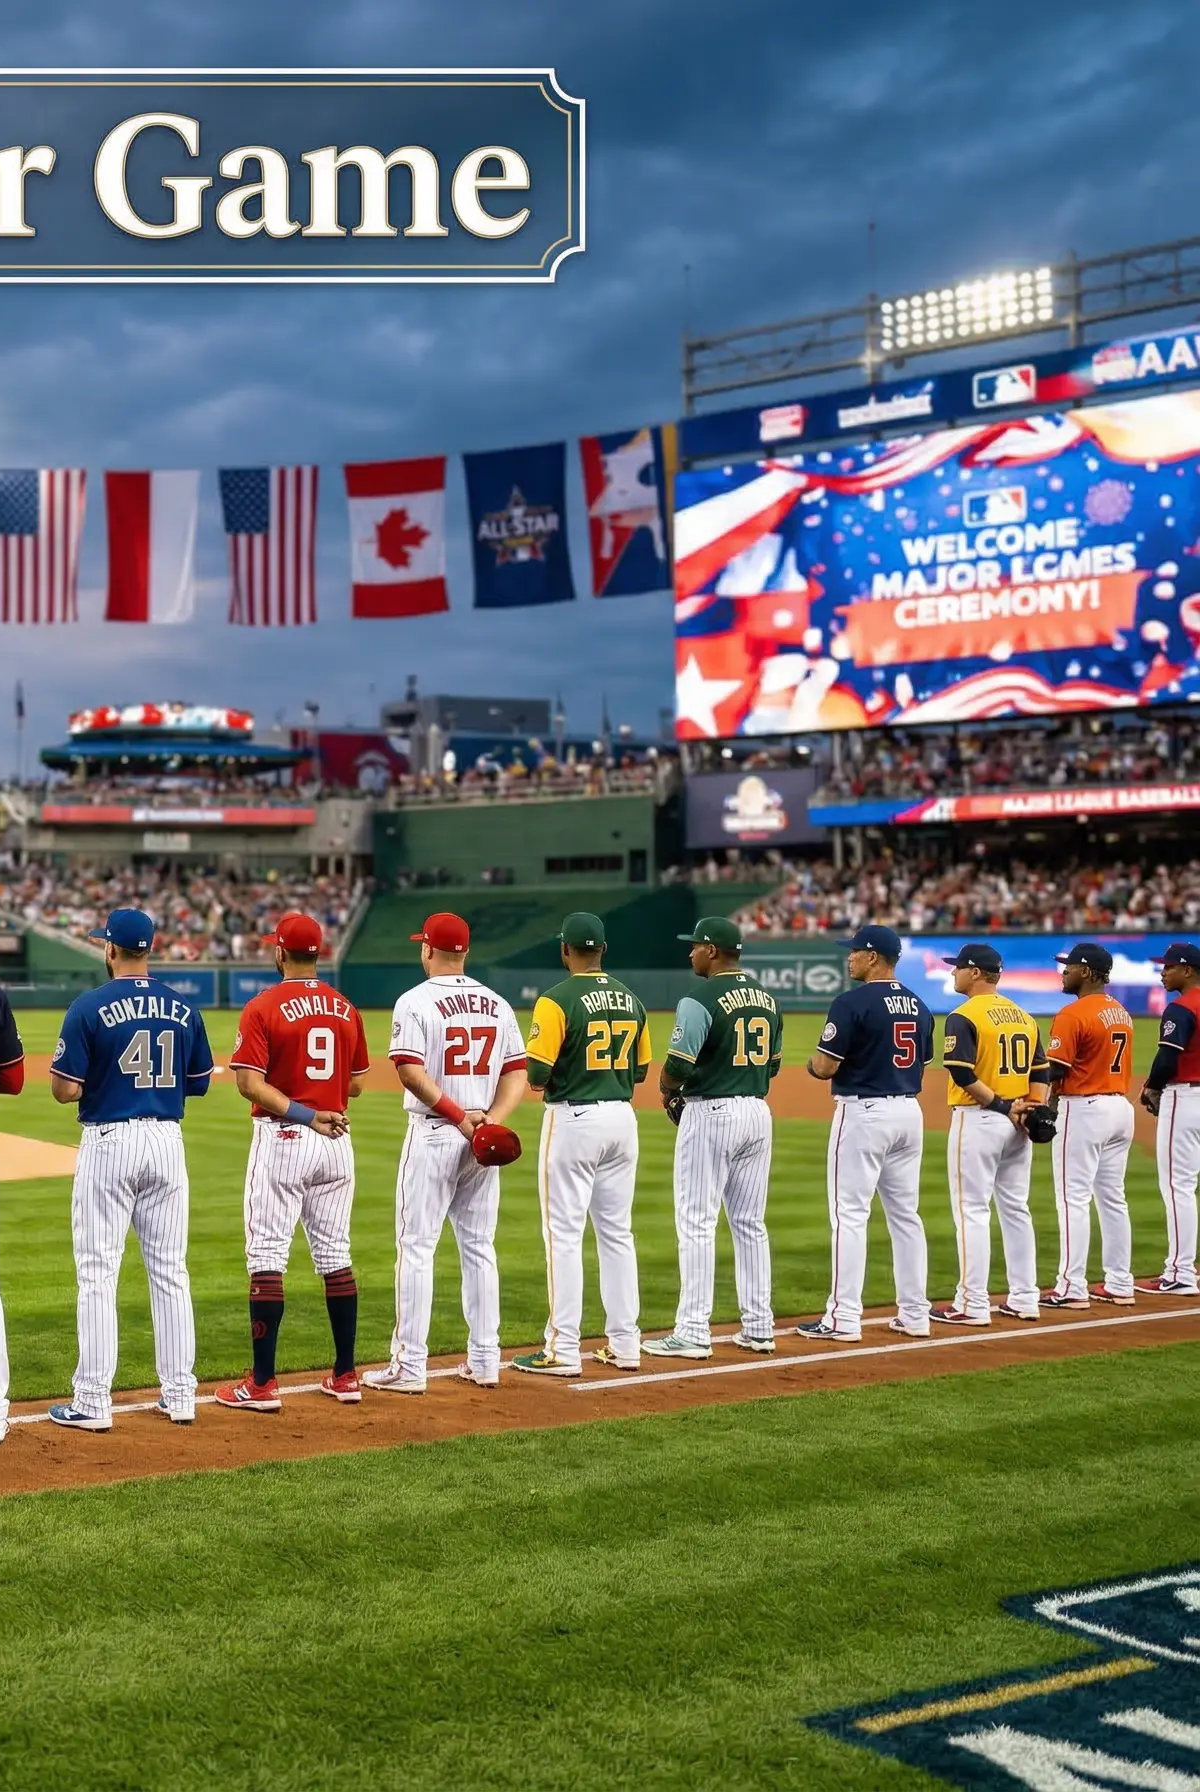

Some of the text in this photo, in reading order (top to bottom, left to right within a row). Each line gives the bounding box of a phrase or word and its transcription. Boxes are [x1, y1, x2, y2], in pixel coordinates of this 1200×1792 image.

[901, 518, 1080, 566] WELCOME
[871, 560, 1001, 600] MAJOR
[894, 579, 1101, 628] CEREMONY!
[98, 996, 191, 1028] GONZALEZ
[280, 995, 352, 1022] GONALEZ
[118, 1030, 177, 1088] 41
[306, 1027, 335, 1080] 9
[444, 1026, 497, 1075] 27
[586, 1020, 638, 1070] 27
[732, 1017, 770, 1066] 13
[892, 1021, 916, 1069] 5
[998, 1032, 1031, 1076] 10
[1109, 1031, 1127, 1074] 7
